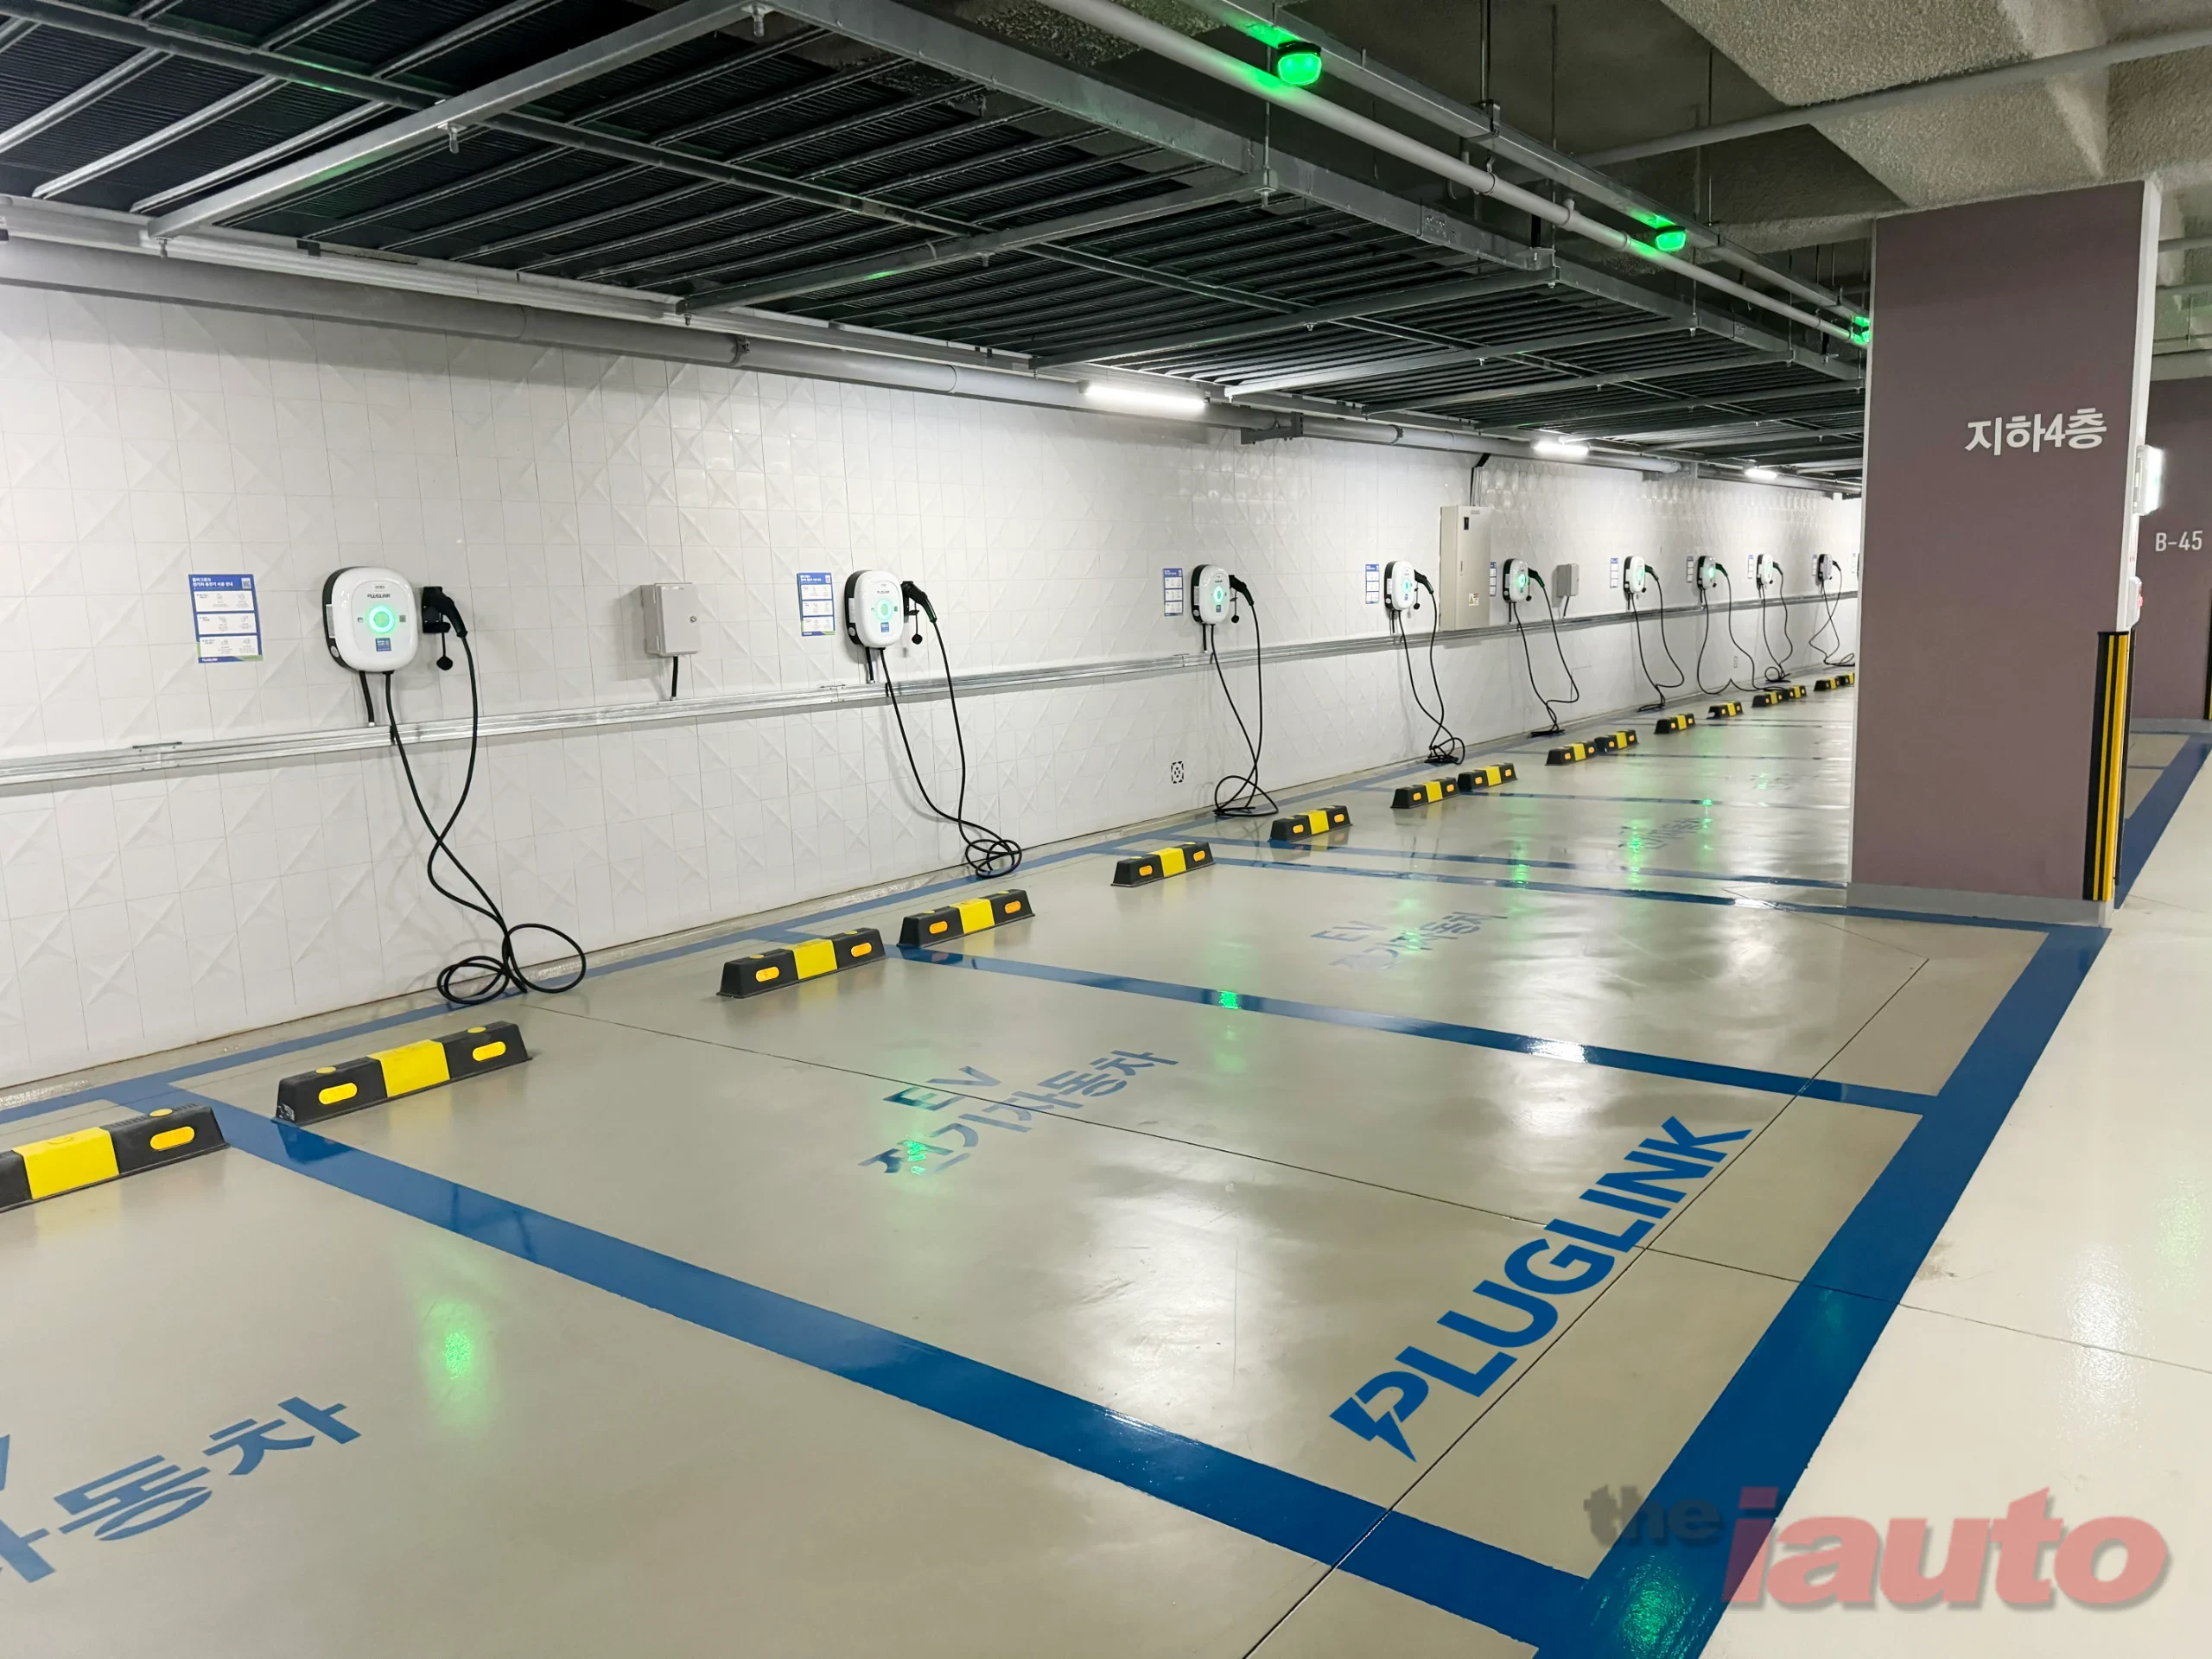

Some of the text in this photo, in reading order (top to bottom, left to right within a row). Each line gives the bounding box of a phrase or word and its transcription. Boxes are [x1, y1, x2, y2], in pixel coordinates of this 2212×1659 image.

[1964, 408, 2107, 456] 지하4층
[2154, 530, 2202, 552] B-45
[1310, 920, 1388, 943] EV
[858, 1049, 1179, 1174] 전기자동차
[882, 1065, 1002, 1112] EV
[1328, 1116, 1753, 1463] PLUGLINK
